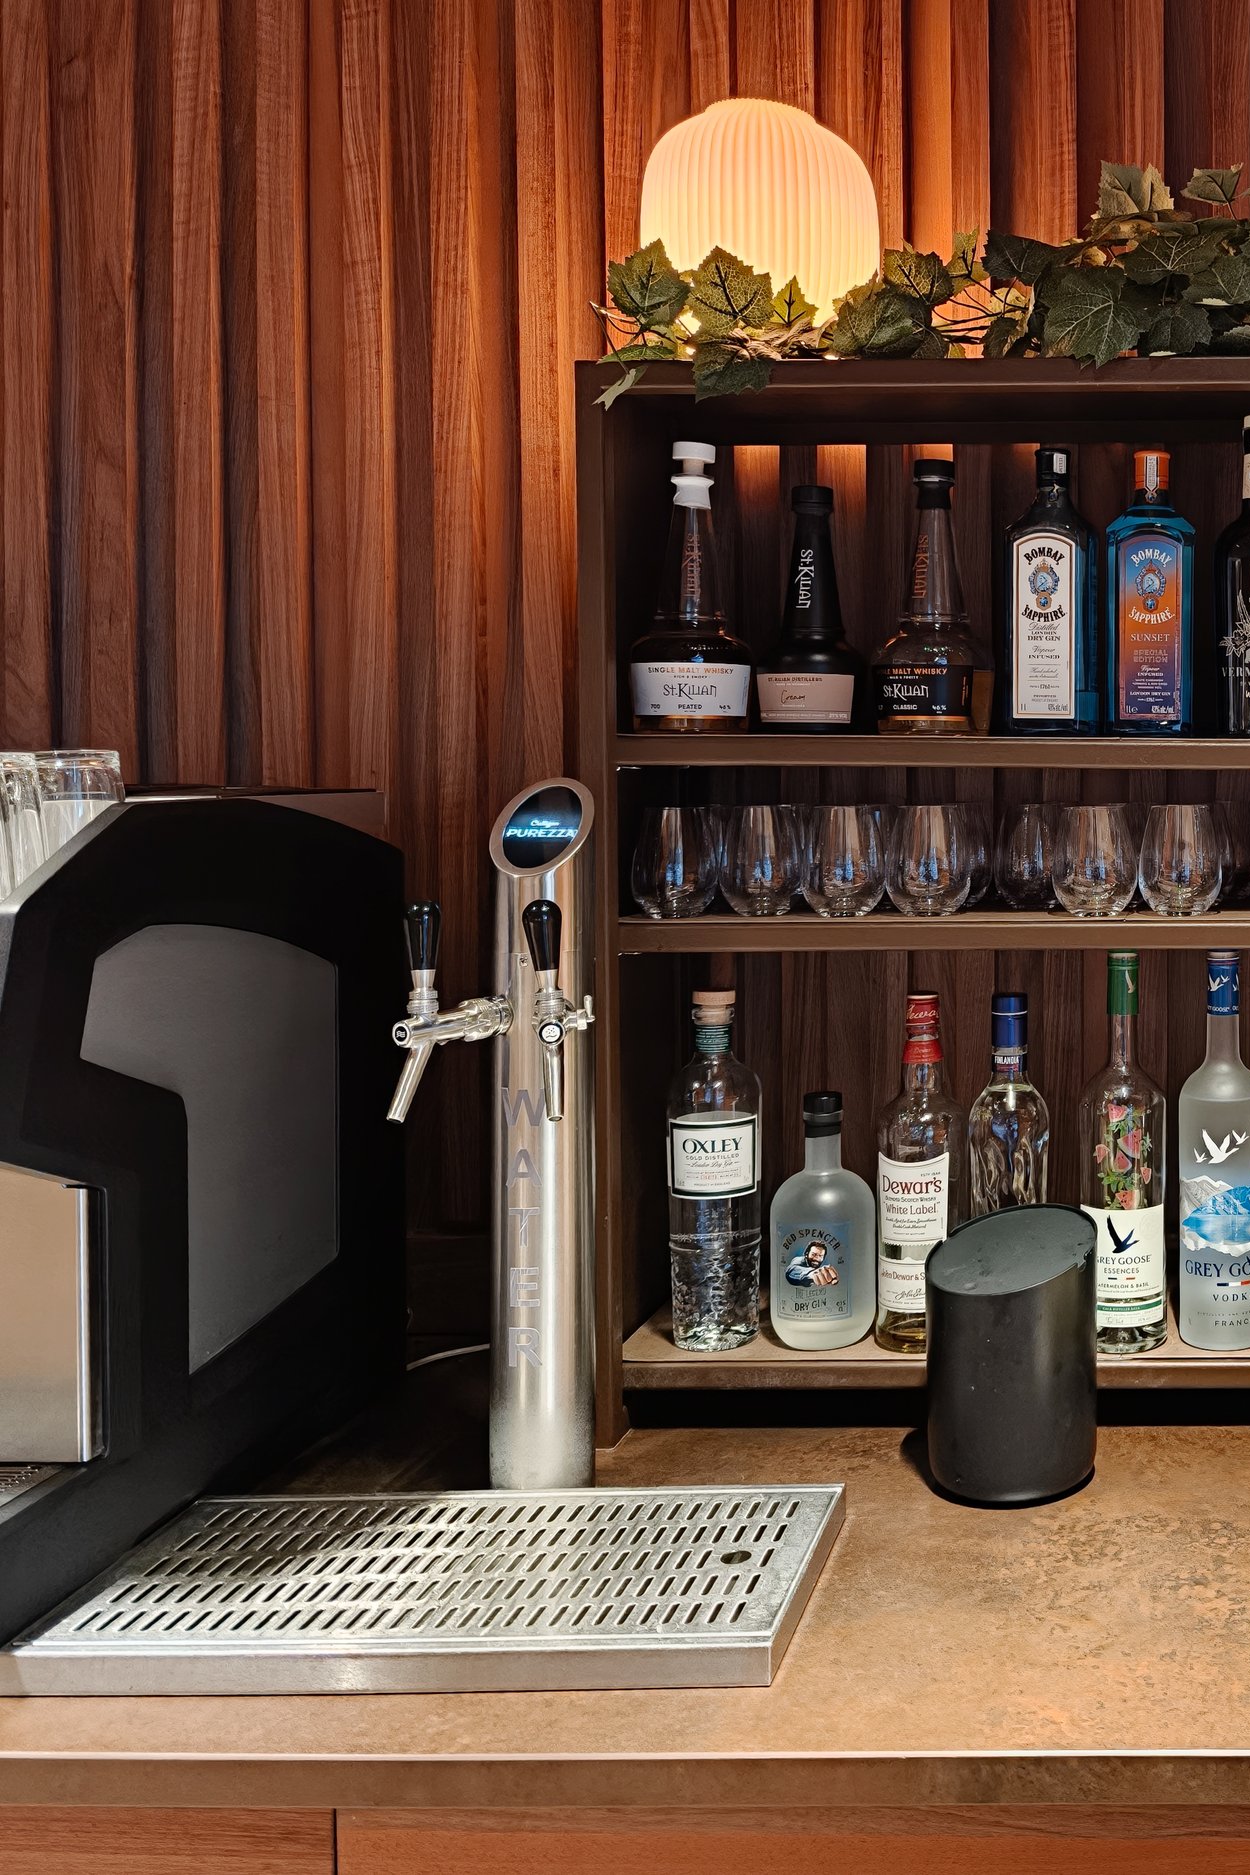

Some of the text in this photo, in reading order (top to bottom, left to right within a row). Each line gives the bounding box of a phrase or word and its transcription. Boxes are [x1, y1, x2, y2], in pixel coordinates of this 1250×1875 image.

[1023, 546, 1066, 565] BOMBAY
[1130, 548, 1172, 567] BOMBAY
[1021, 604, 1067, 623] SAPPHIRE
[1128, 606, 1174, 625] SAPPHIRE
[1130, 633, 1170, 642] SUNSET
[648, 666, 734, 675] SINGLE MALT WHISKY
[505, 828, 578, 838] PUREZZA
[682, 1137, 742, 1154] OXLEY
[704, 1153, 740, 1161] DISTILLED
[882, 1174, 942, 1195] Dewar's
[501, 1087, 546, 1368] WATER
[783, 1229, 841, 1251] BUD SPENCER
[1118, 1255, 1151, 1265] GOOSE
[1185, 1259, 1224, 1278] GREY
[892, 1271, 914, 1281] Dewar
[794, 1298, 827, 1312] DRY GIN
